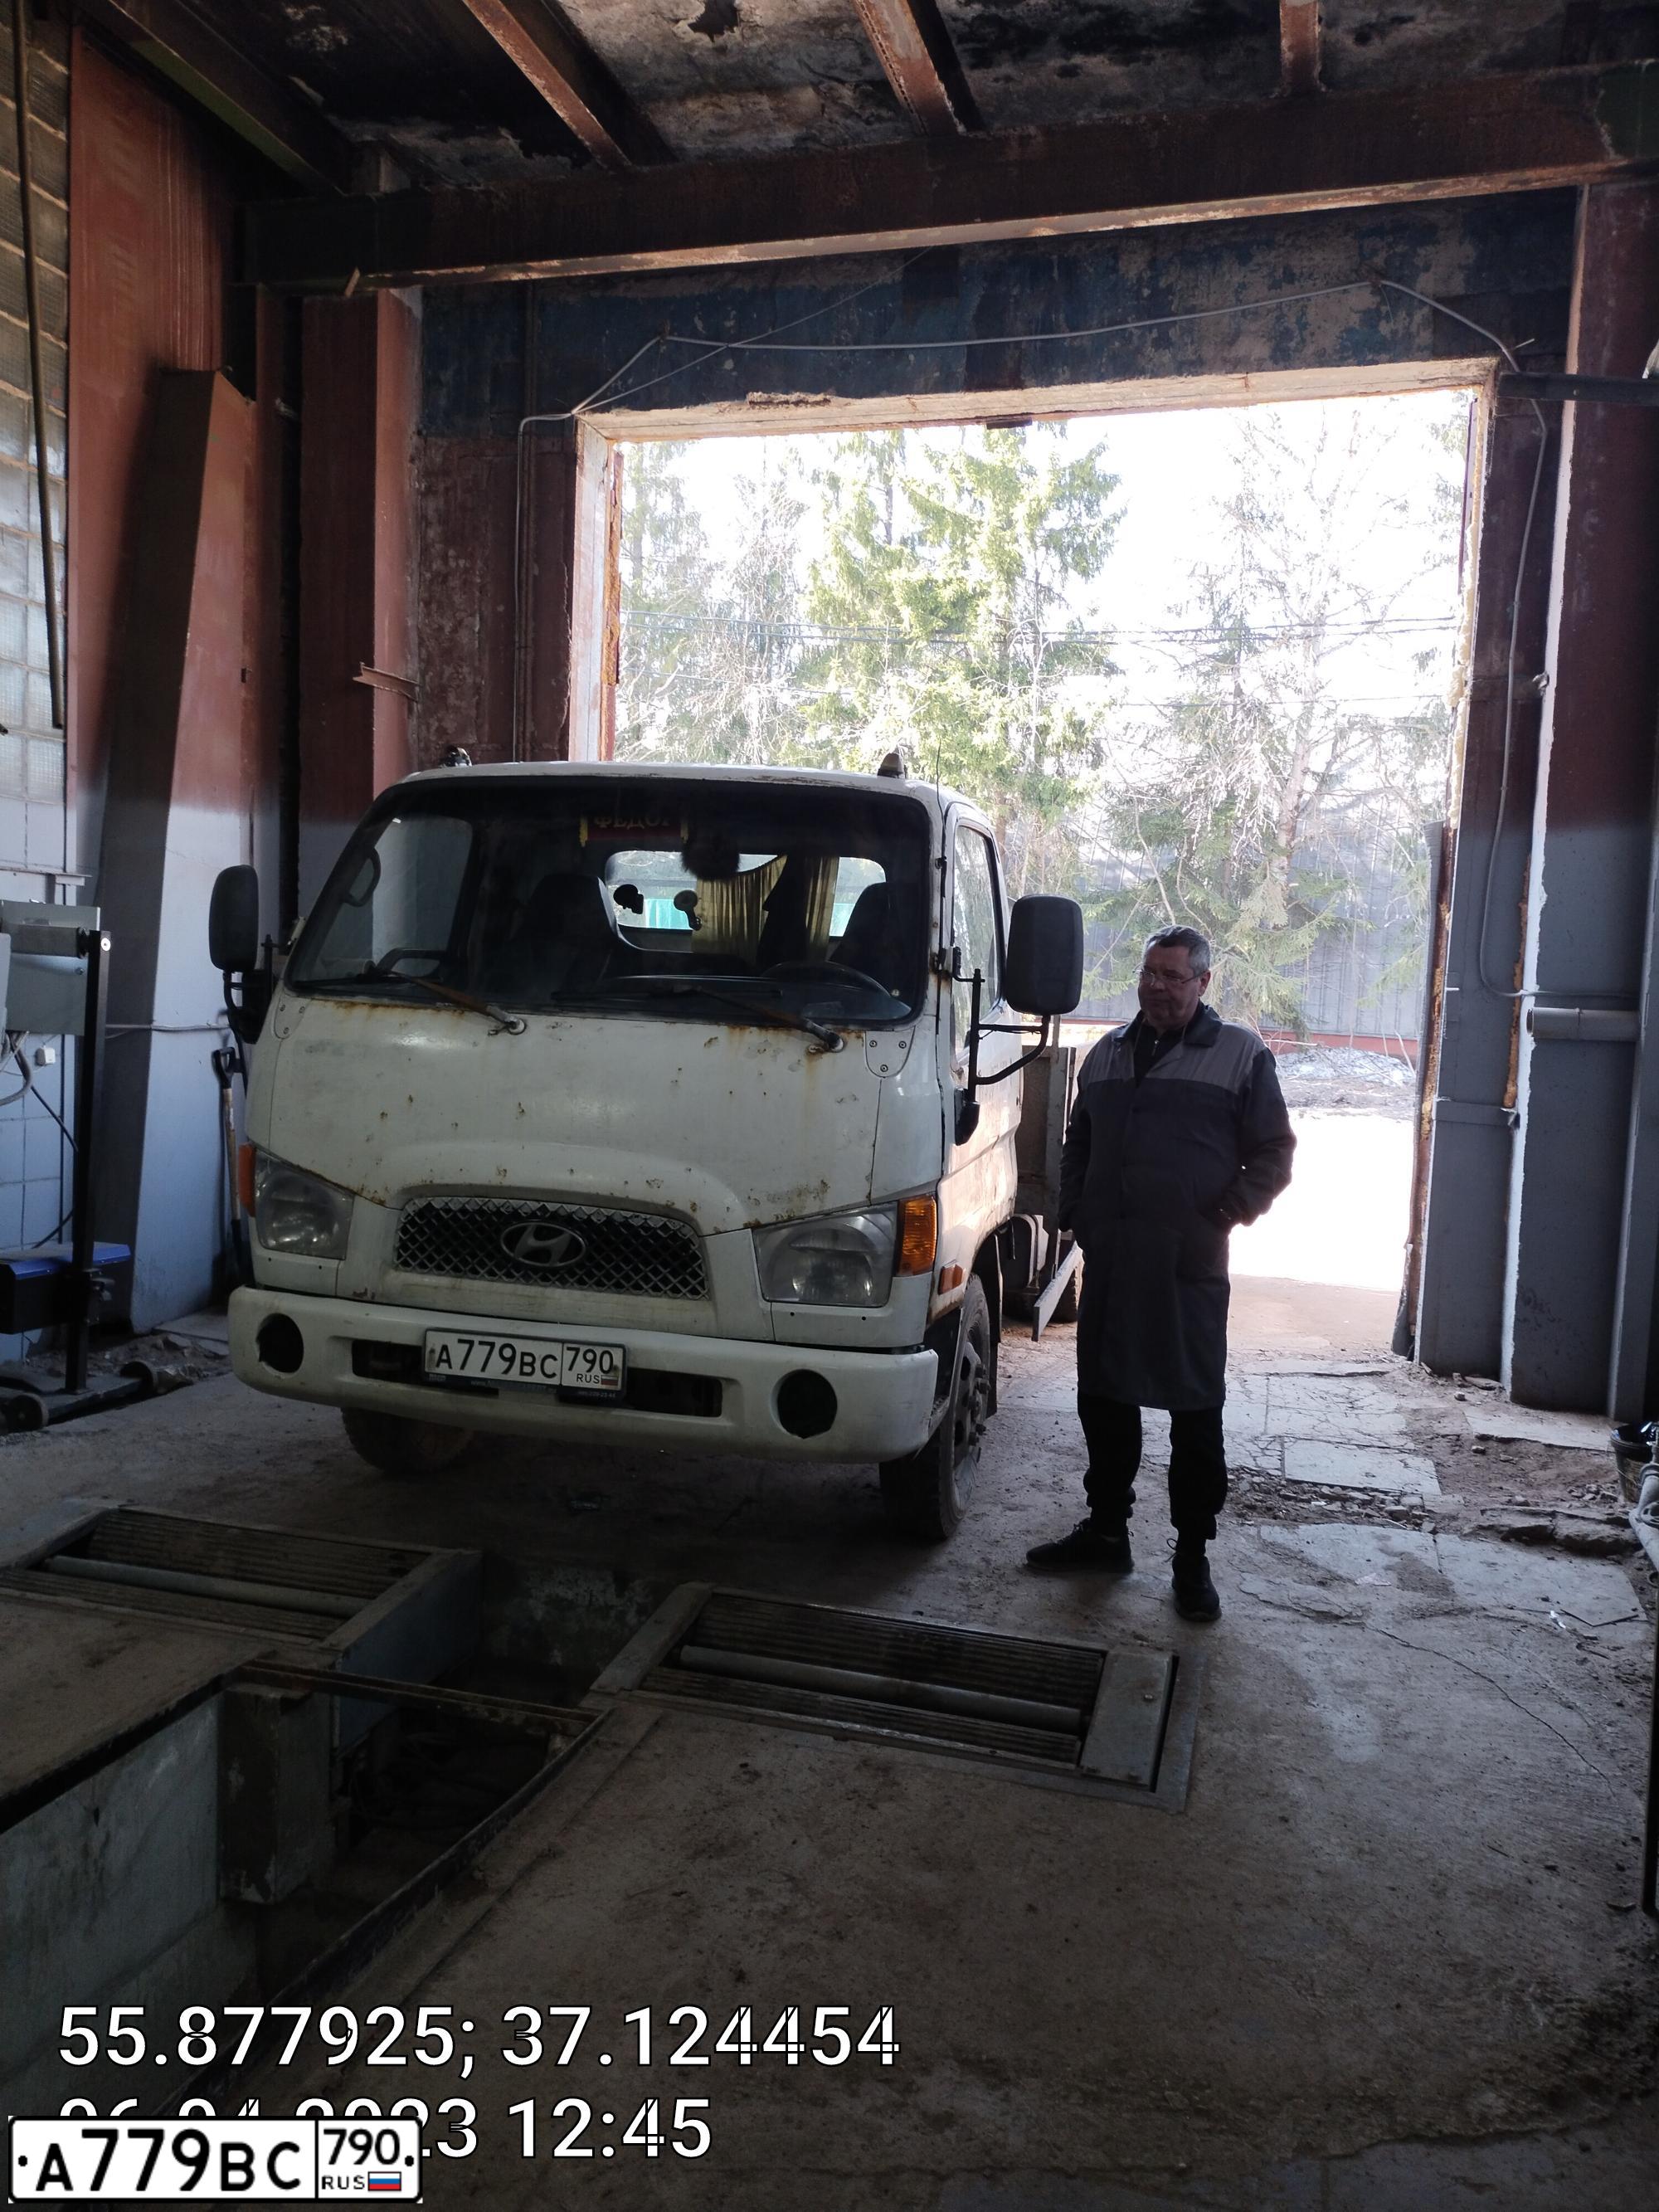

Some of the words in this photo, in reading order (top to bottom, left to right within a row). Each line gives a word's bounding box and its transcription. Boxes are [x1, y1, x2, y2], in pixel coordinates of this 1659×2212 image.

[435, 1338, 558, 1379] А779ВС
[566, 1346, 614, 1374] 790
[576, 1372, 601, 1385] RUS
